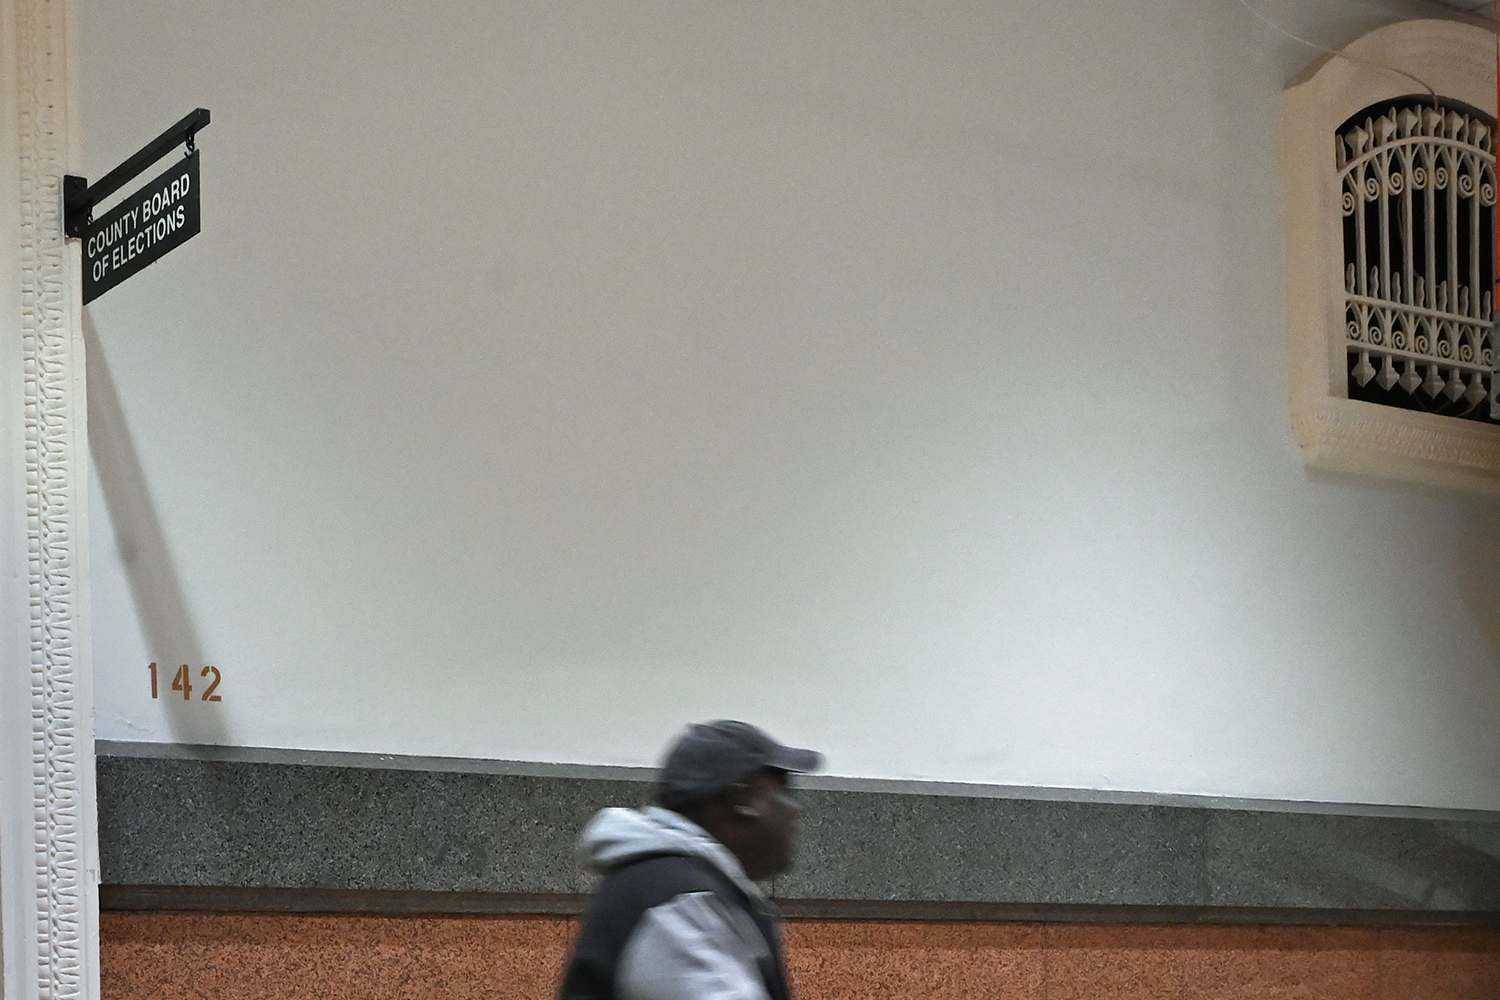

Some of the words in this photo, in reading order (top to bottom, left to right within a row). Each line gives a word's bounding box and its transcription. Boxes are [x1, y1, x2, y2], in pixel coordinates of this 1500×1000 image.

[87, 206, 139, 258] COUNTY
[142, 173, 190, 223] BOARD
[93, 254, 110, 282] OF
[112, 205, 185, 270] ELECTIONS
[148, 662, 222, 702] 142
